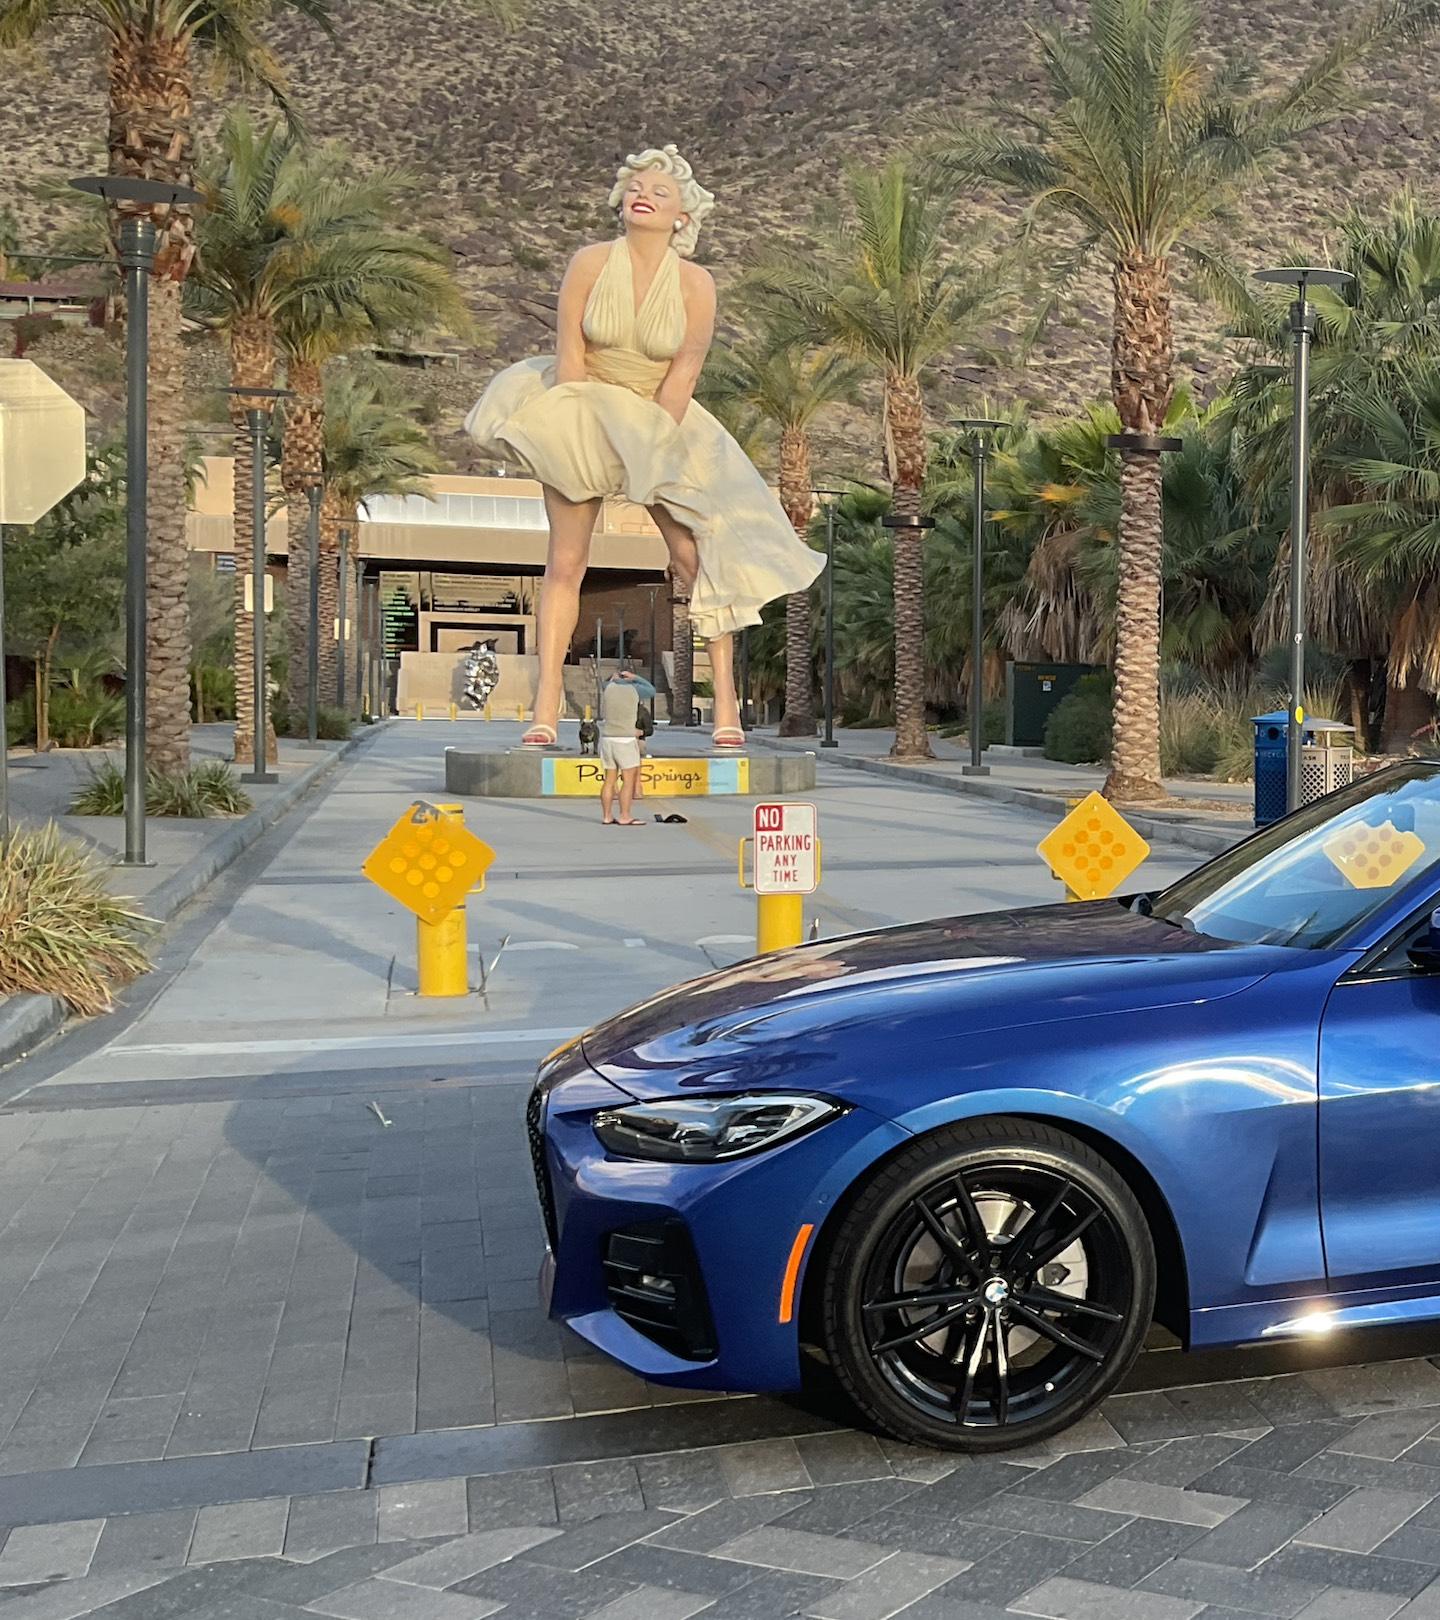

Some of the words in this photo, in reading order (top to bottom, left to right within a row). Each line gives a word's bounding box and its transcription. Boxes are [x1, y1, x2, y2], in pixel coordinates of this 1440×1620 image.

[640, 764, 702, 789] Springs
[759, 808, 780, 828] NO
[760, 834, 811, 851] PARKING
[774, 855, 797, 867] ANY
[773, 870, 798, 882] TIME
